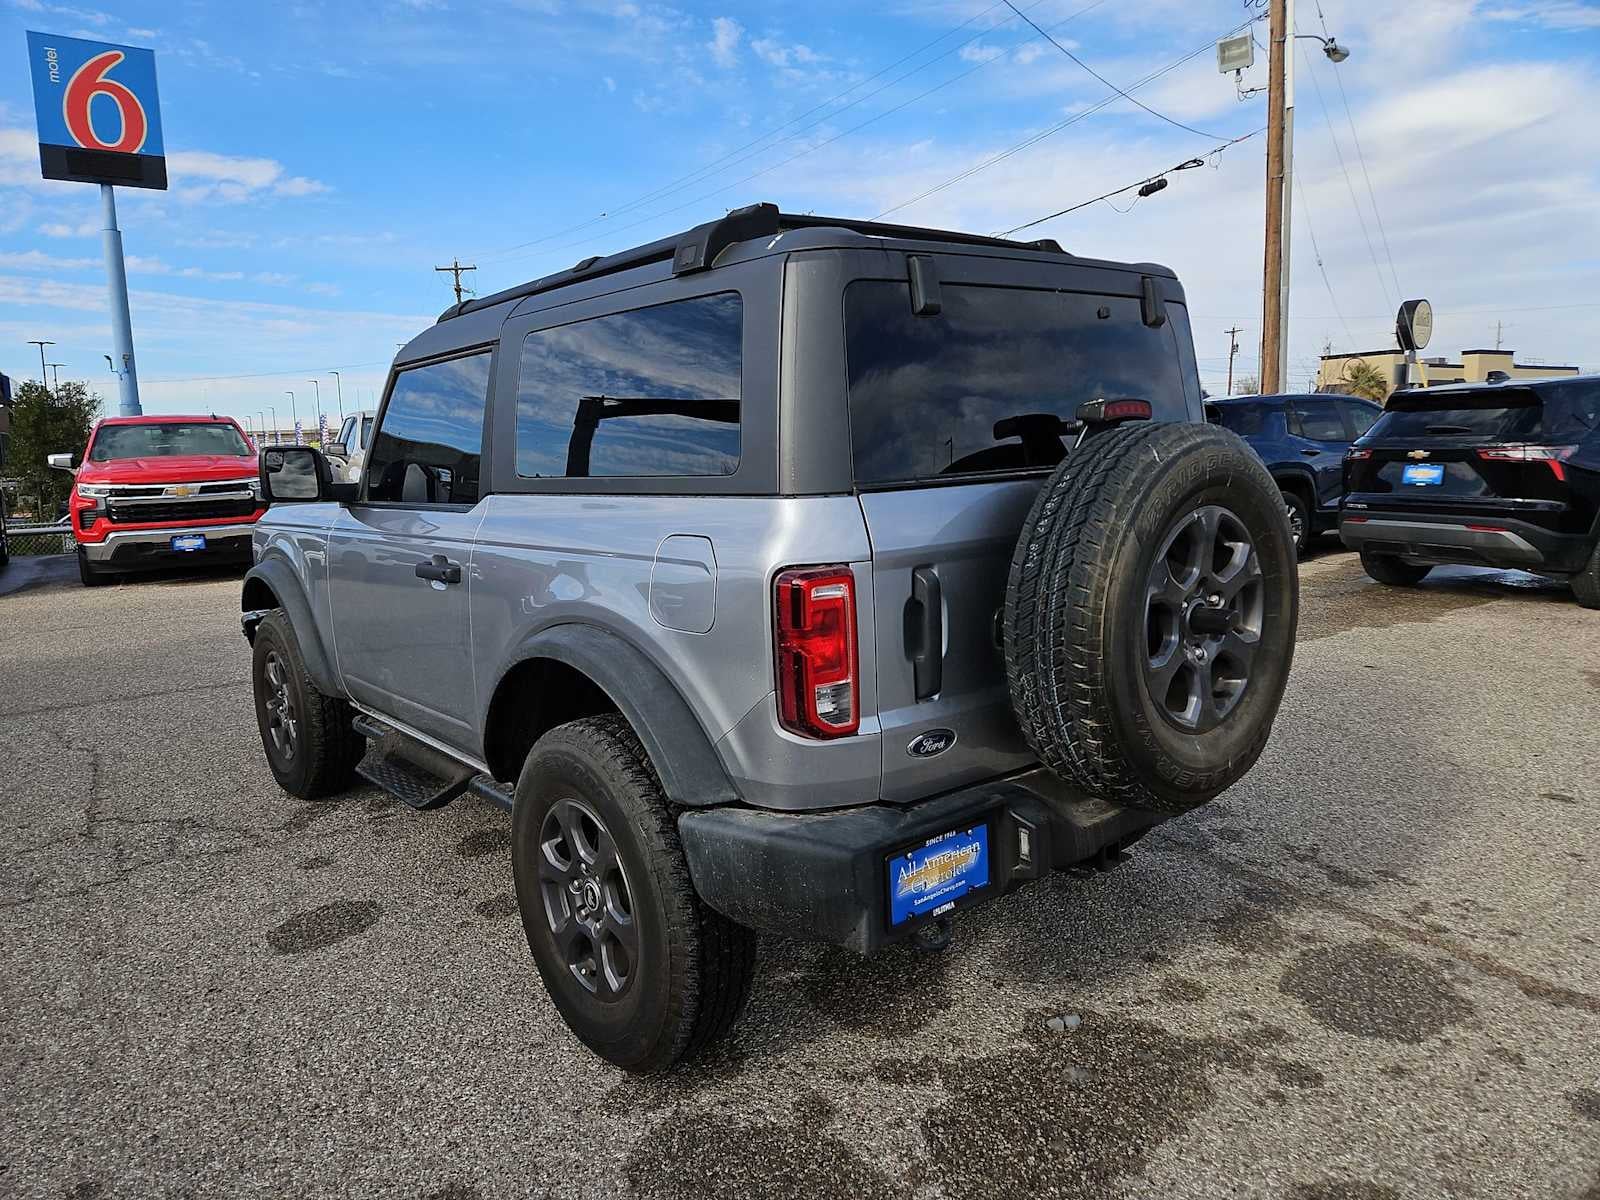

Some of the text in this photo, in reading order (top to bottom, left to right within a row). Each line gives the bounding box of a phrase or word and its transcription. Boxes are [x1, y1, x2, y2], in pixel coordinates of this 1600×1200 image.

[43, 47, 60, 83] motel
[63, 50, 148, 154] 6
[920, 737, 946, 754] Ford
[925, 834, 943, 847] SINCE
[897, 841, 981, 883] All American
[913, 880, 966, 906] SanAngeloChevy.com
